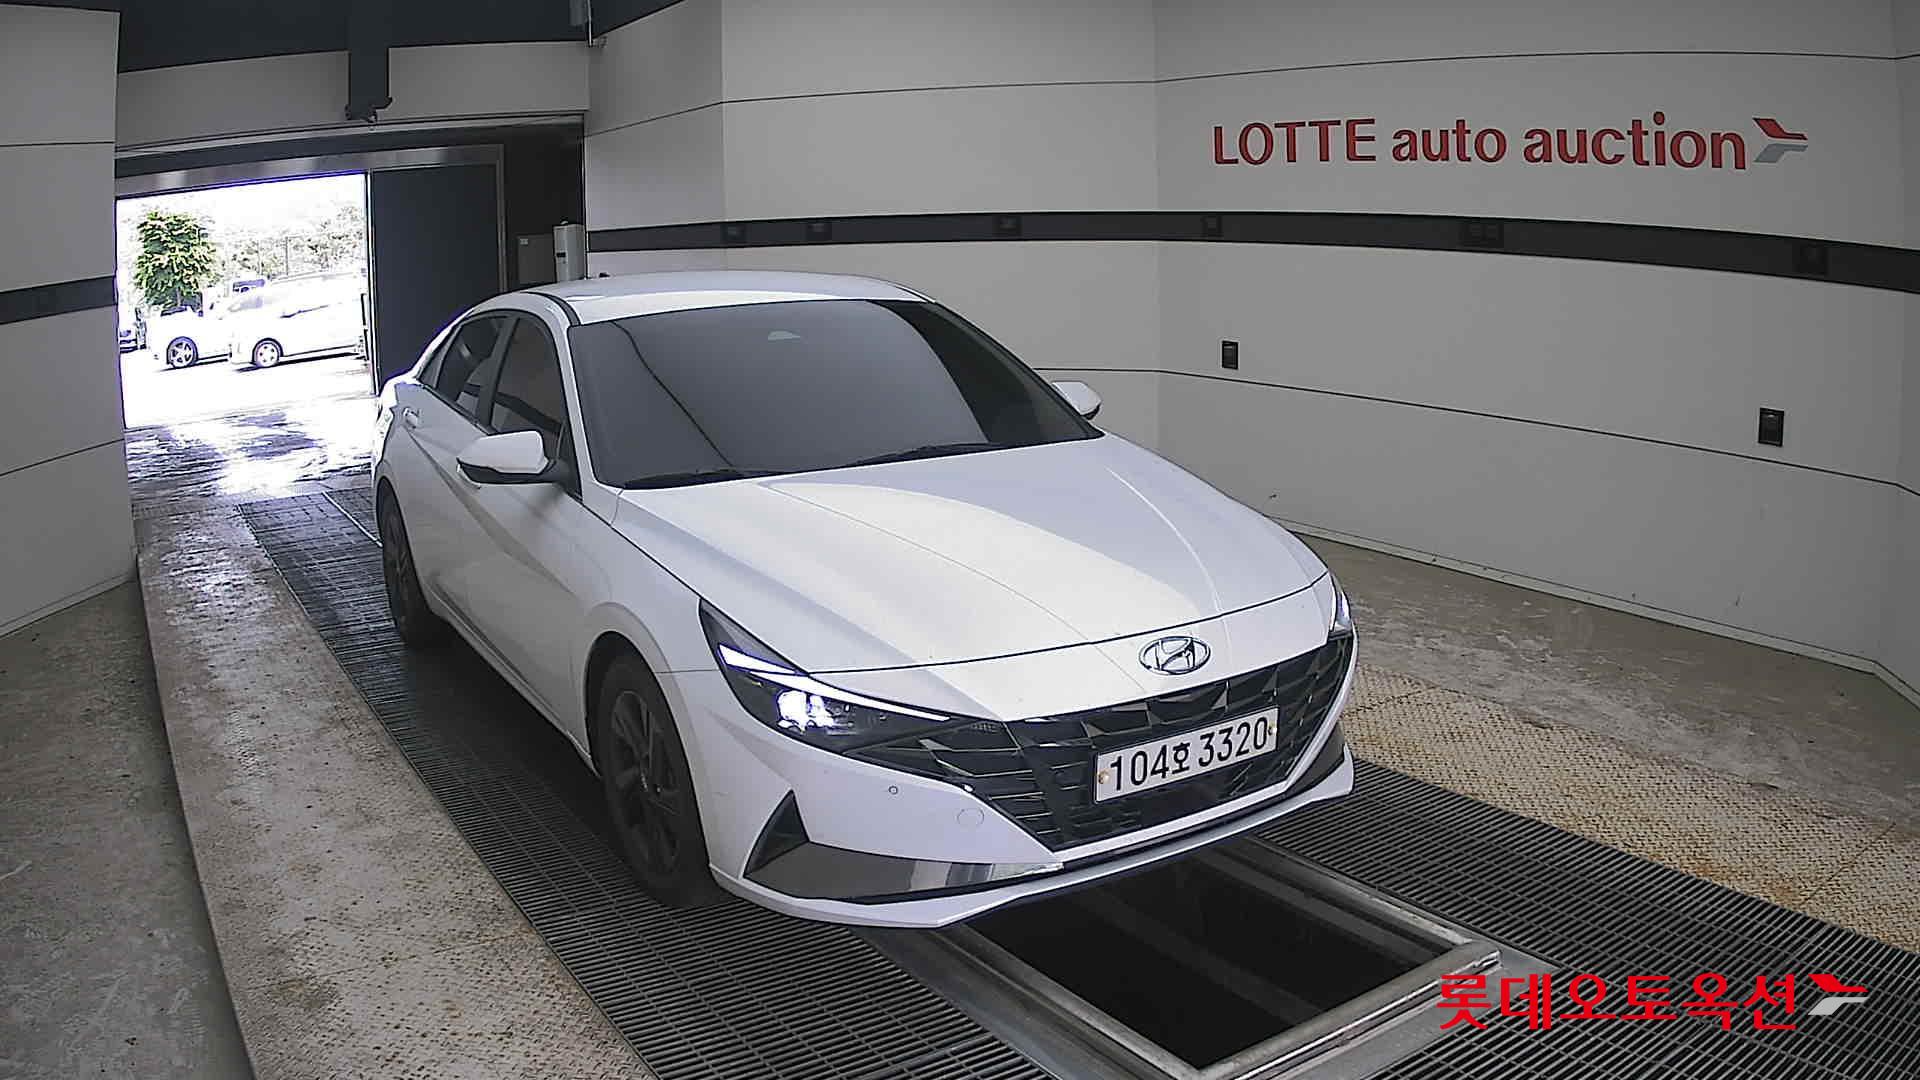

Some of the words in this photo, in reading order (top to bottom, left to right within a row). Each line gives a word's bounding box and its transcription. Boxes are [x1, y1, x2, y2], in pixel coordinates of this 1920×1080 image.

[1213, 118, 1377, 166] LOTTE
[1392, 118, 1508, 163] auto
[1523, 111, 1747, 170] auction
[1110, 742, 1190, 791] 104호
[1198, 716, 1268, 767] 3320
